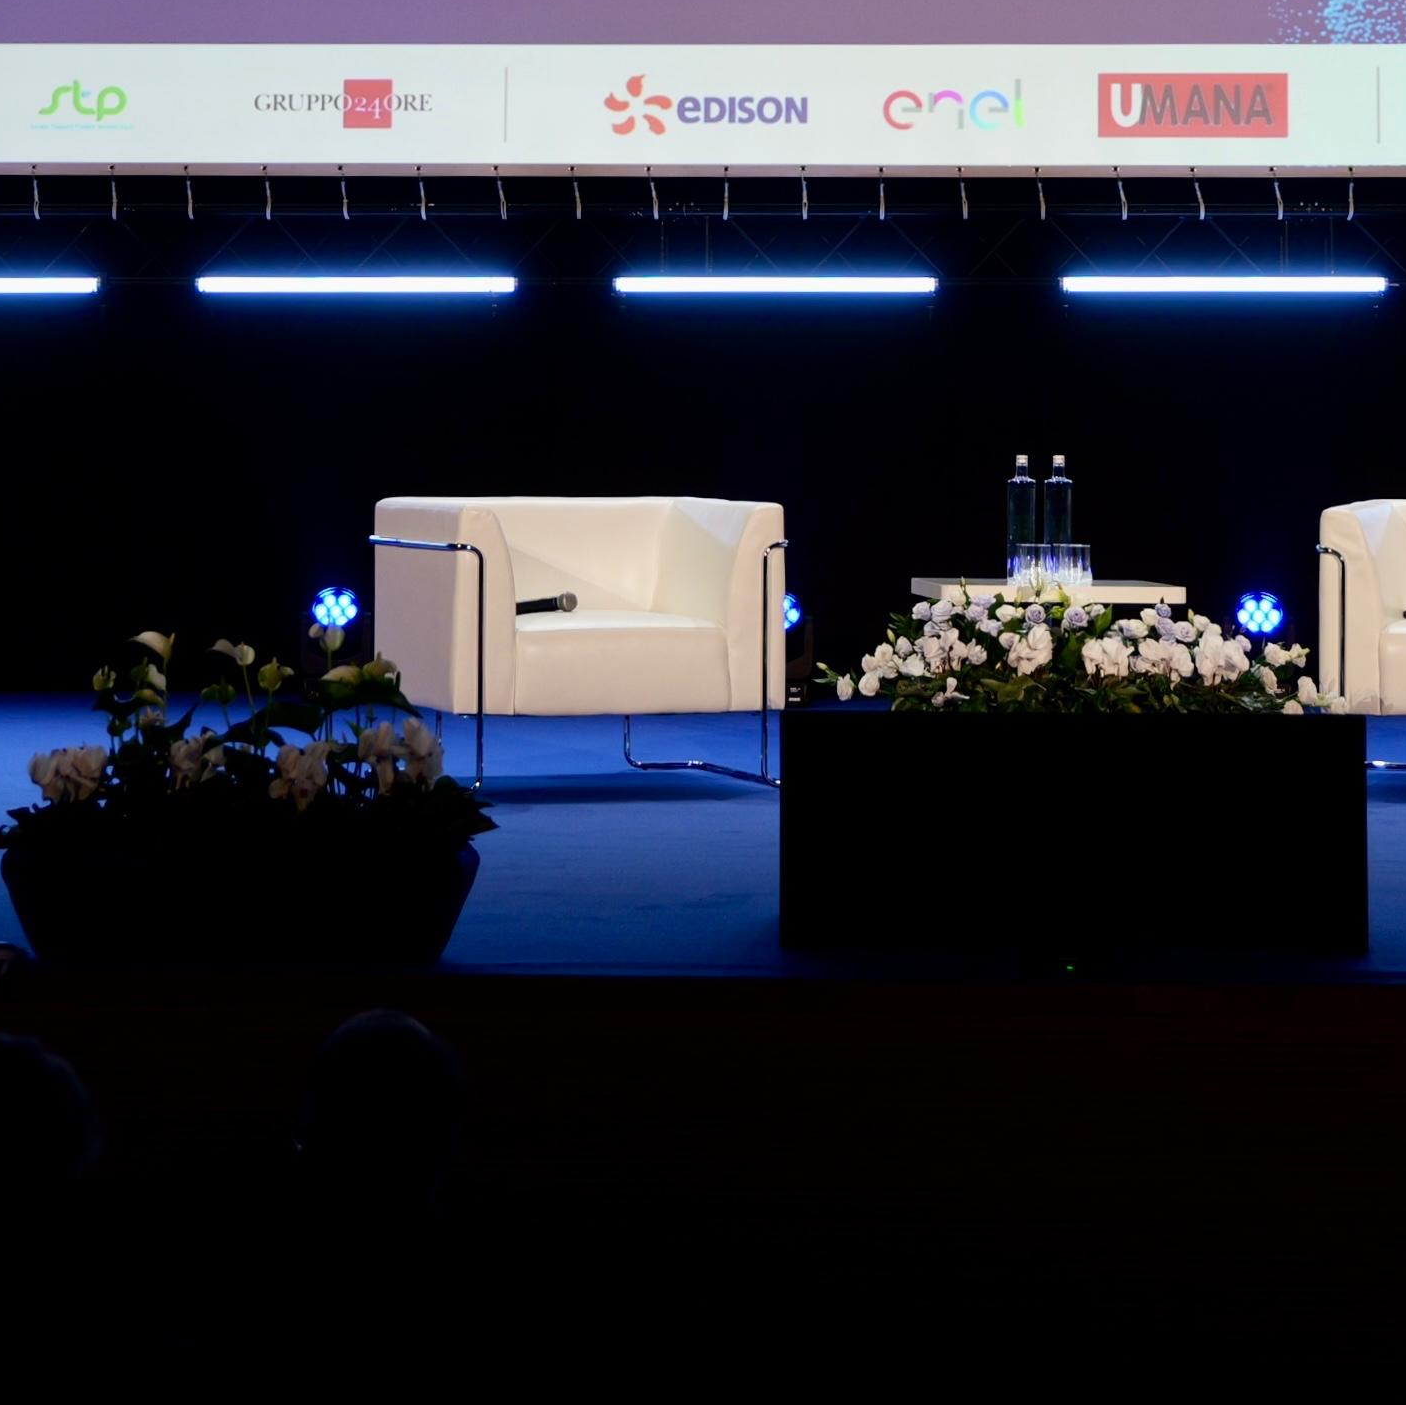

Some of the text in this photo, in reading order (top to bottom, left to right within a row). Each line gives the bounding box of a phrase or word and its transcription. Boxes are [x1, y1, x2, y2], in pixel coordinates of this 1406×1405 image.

[38, 79, 128, 122] stp
[883, 78, 1026, 131] enel
[1109, 83, 1274, 127] UMANA
